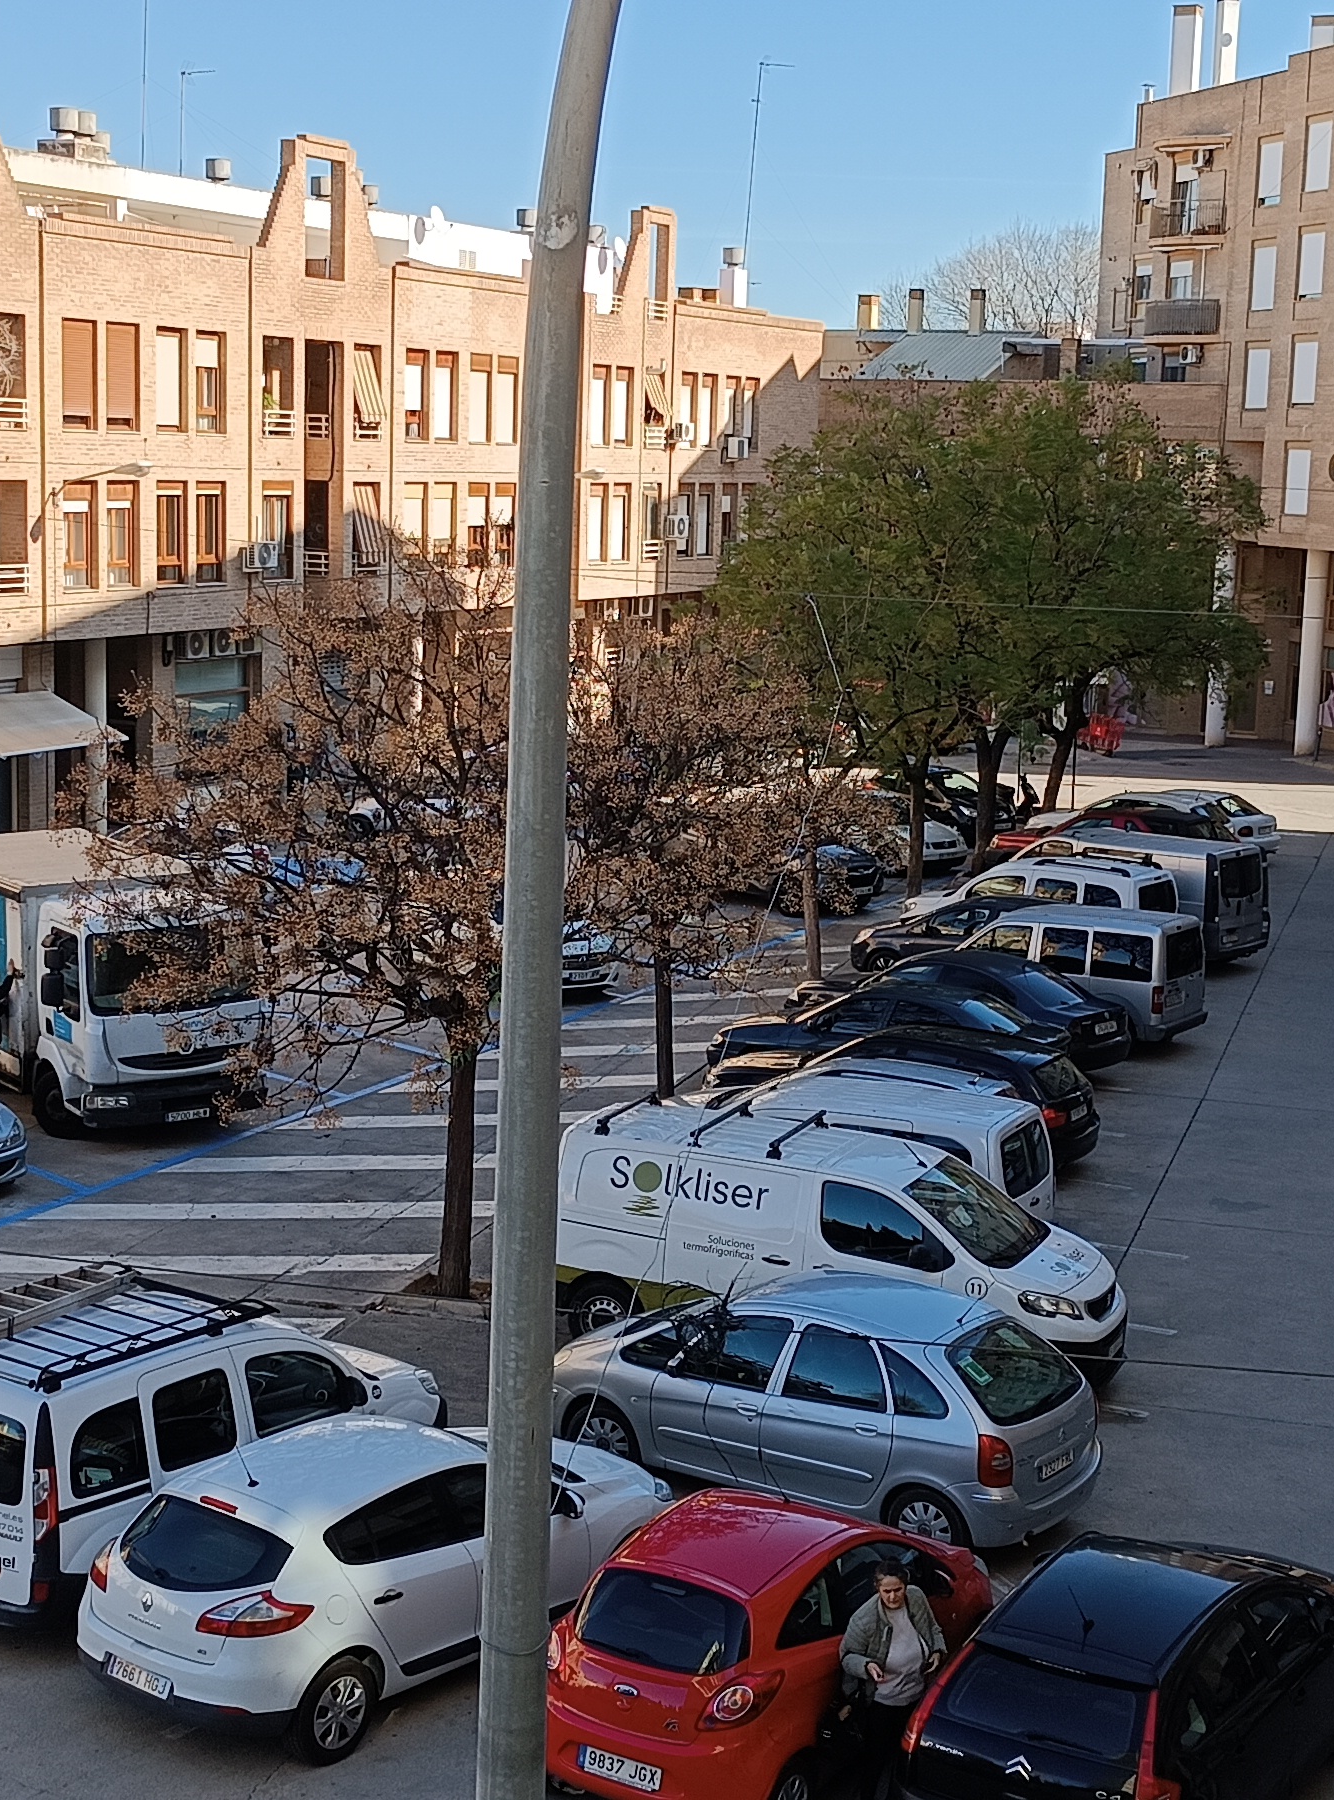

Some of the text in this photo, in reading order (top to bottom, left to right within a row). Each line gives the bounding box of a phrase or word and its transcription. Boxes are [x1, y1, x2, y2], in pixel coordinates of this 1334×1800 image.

[610, 1155, 770, 1210] Solkliser
[707, 1234, 755, 1251] Soluciones
[970, 1282, 982, 1296] 11
[116, 1661, 168, 1695] 7661 HGJ
[588, 1750, 658, 1786] 9837 JGX
